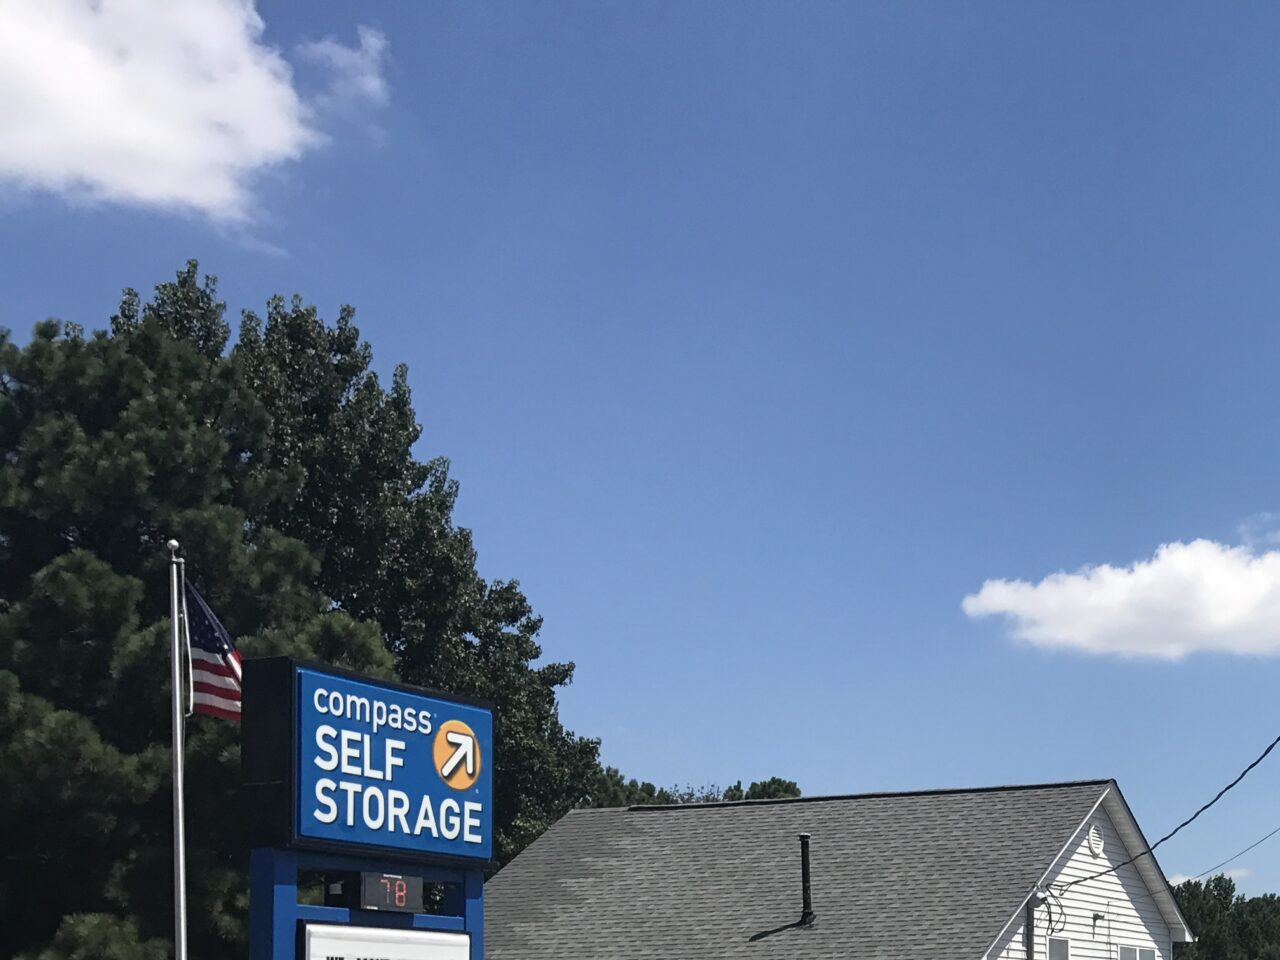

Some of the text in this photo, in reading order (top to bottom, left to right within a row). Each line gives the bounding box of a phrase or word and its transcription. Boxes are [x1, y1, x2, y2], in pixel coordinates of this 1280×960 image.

[313, 688, 432, 734] compass
[313, 724, 406, 781] SELF
[313, 778, 482, 843] STORAGE
[381, 879, 407, 907] 78
